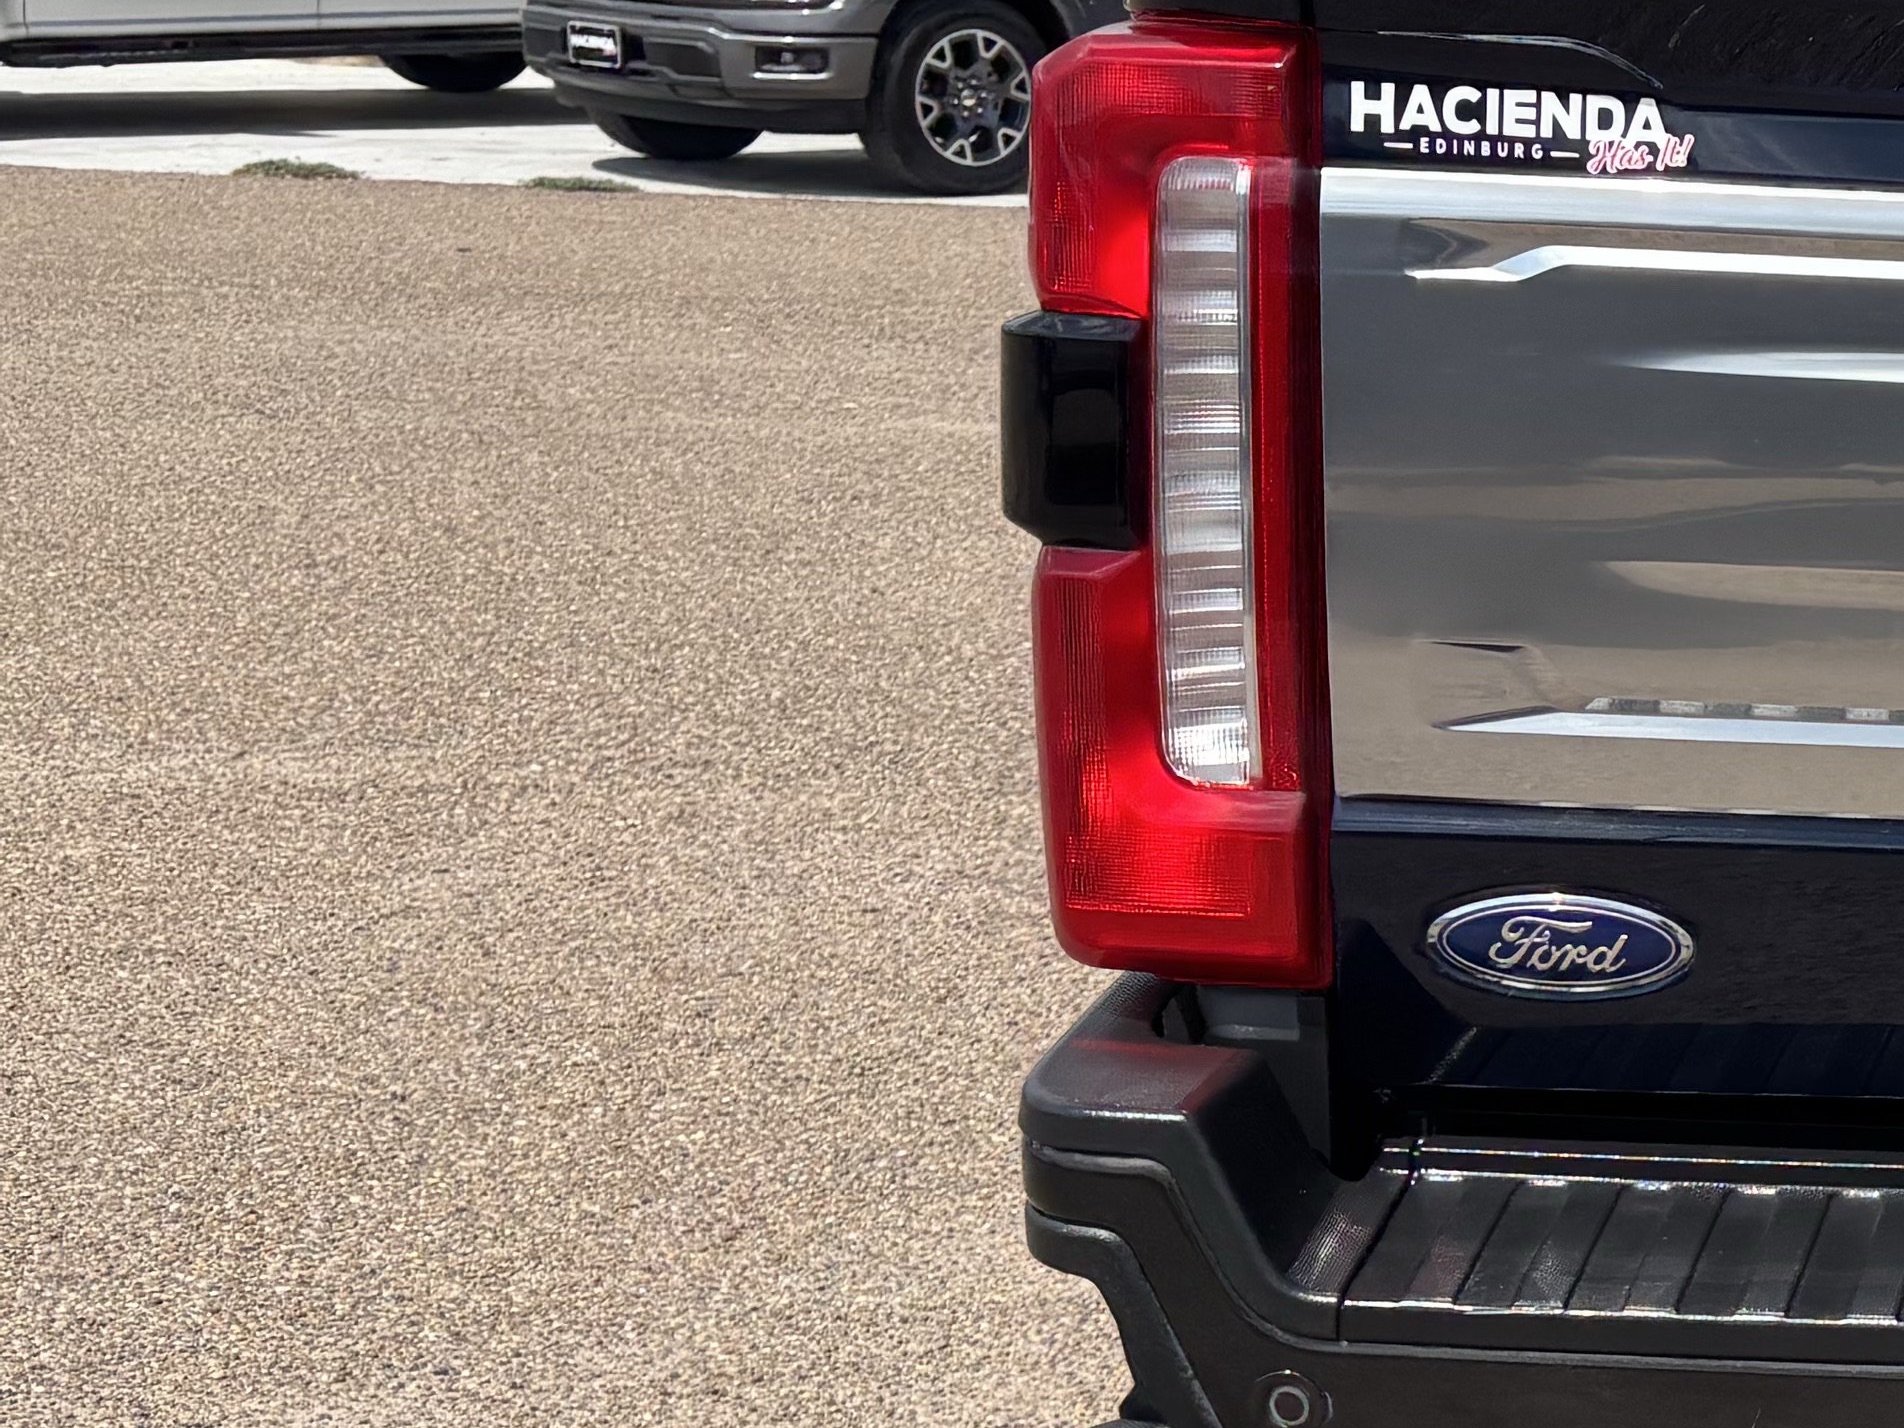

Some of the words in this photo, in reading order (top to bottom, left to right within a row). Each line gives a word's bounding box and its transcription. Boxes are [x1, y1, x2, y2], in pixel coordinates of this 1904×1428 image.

[1350, 80, 1668, 144] HACIENDA
[1419, 137, 1544, 160] EDINBURG
[1586, 138, 1654, 174] Has
[1488, 915, 1629, 973] Ford
